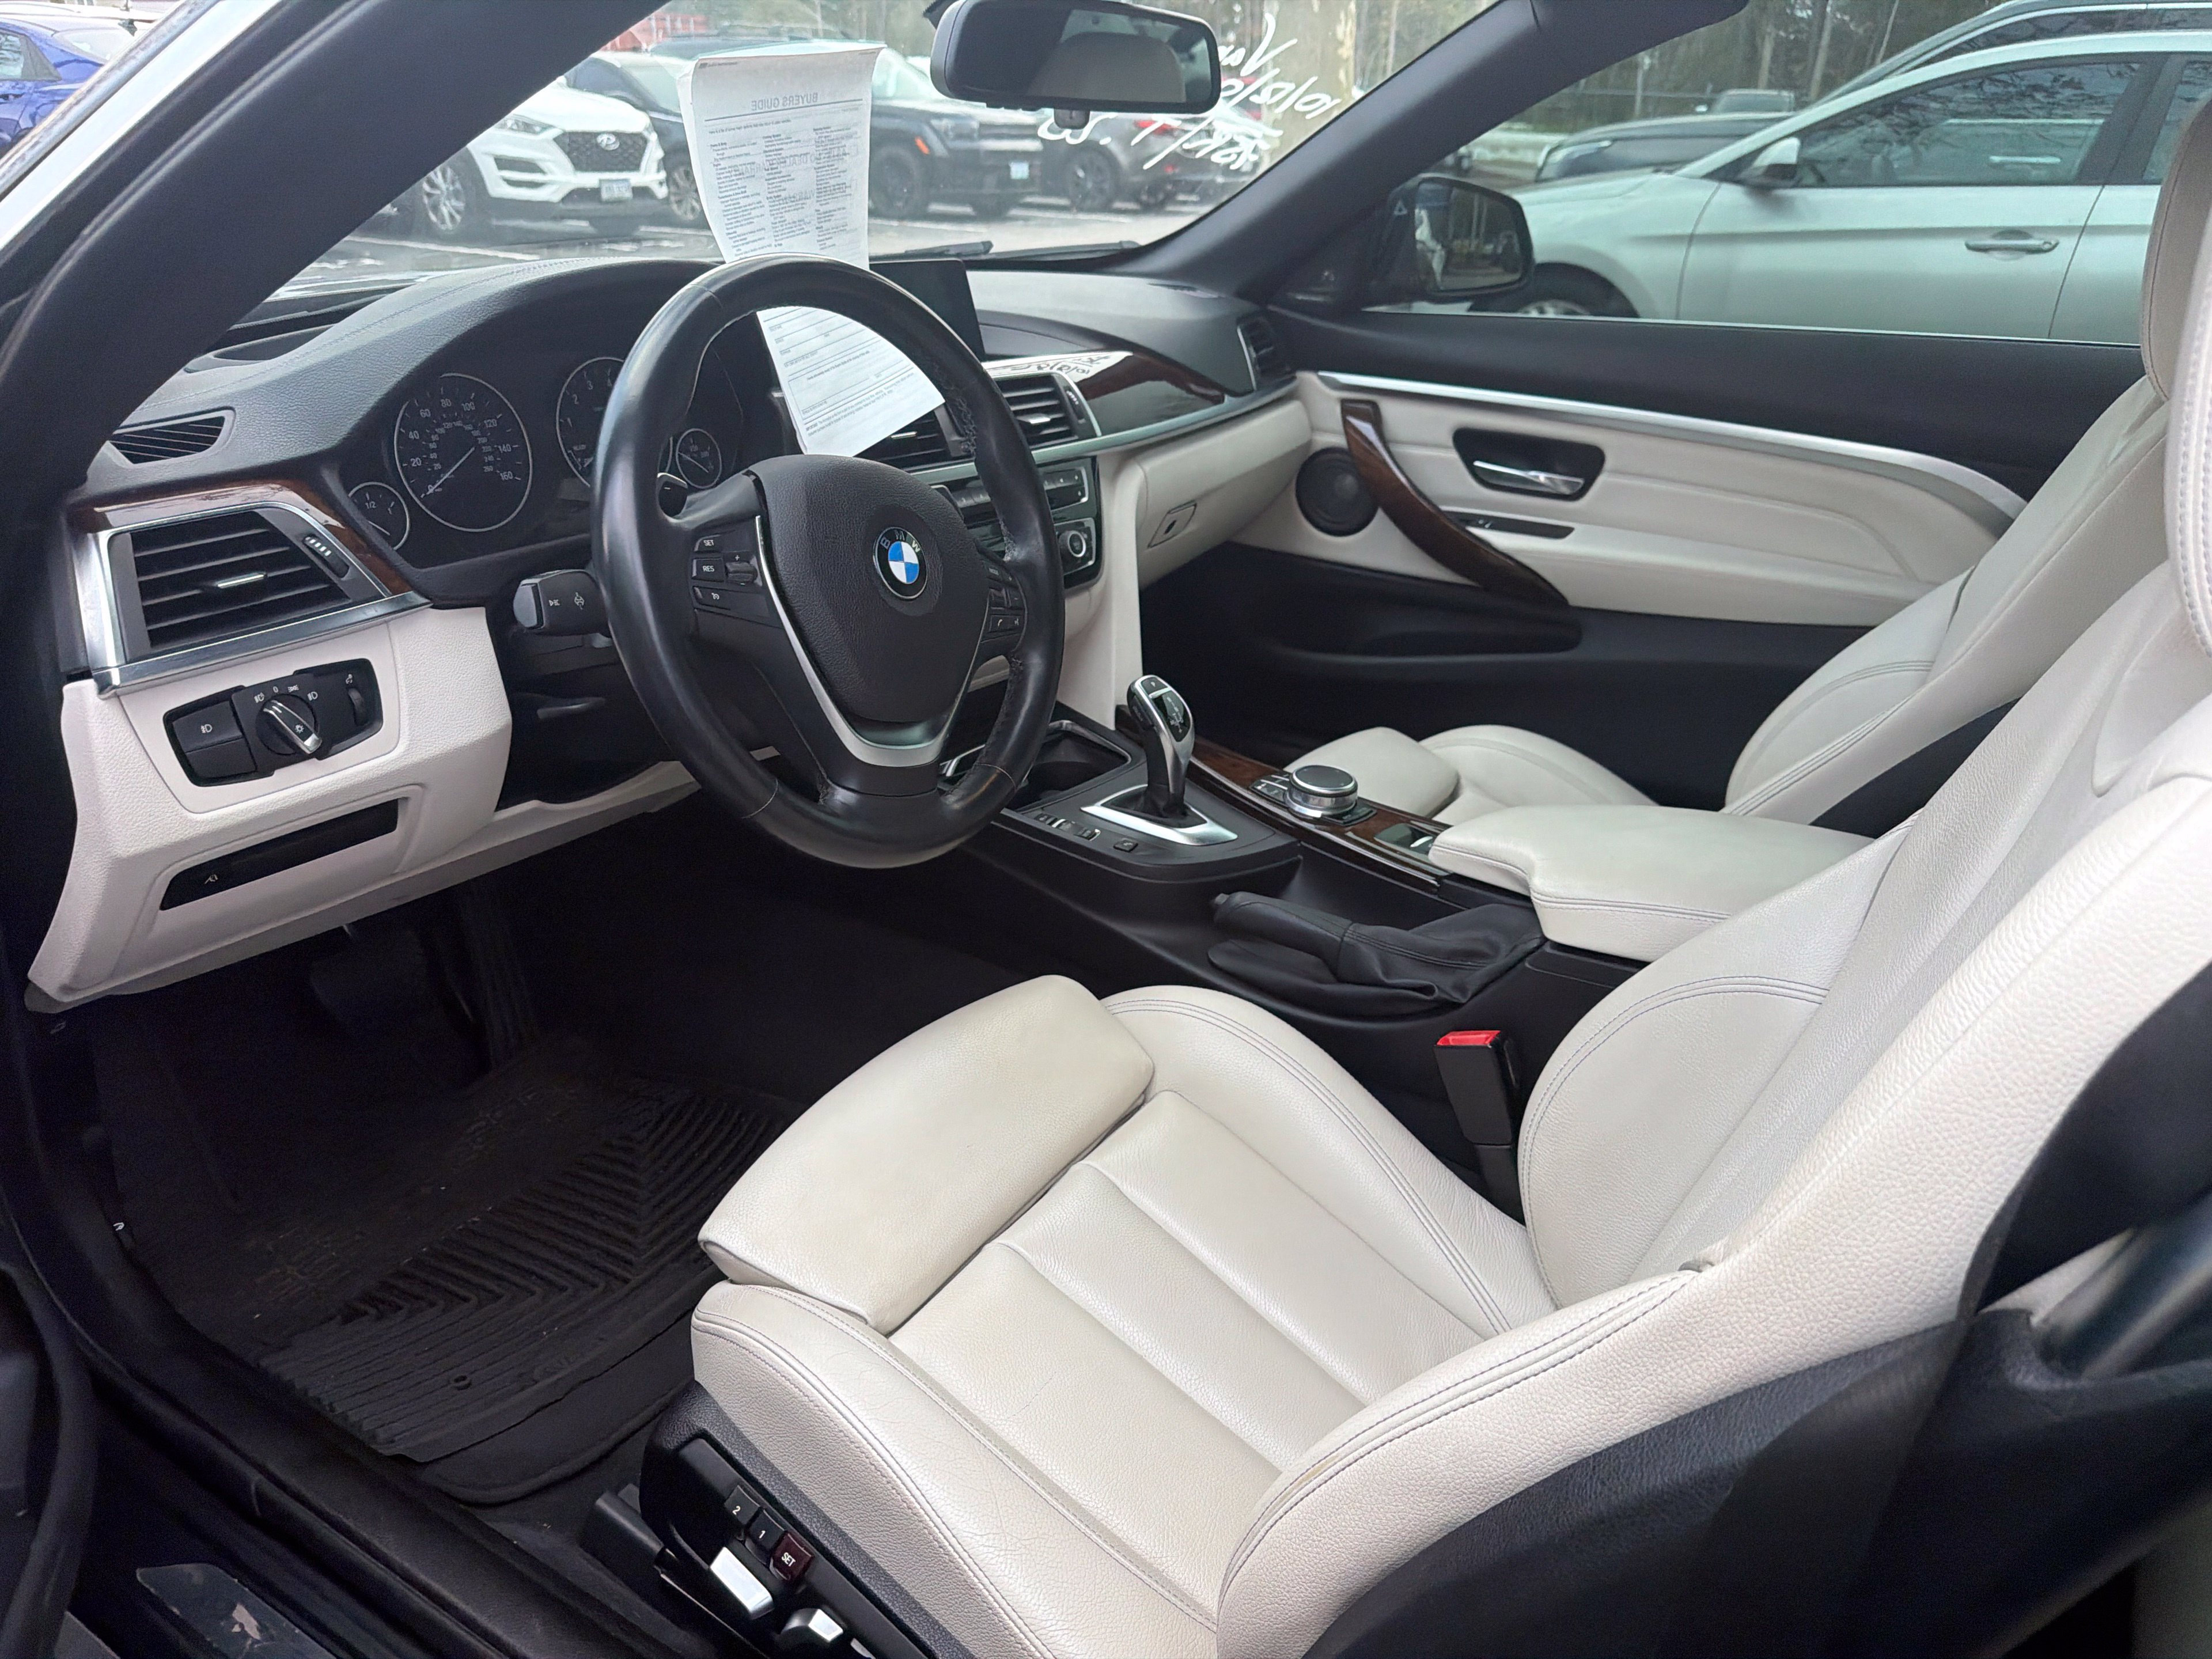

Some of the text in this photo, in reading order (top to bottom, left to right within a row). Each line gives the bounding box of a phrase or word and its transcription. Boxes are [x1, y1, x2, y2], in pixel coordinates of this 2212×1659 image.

[586, 380, 593, 390] 3
[440, 399, 452, 408] 80
[573, 394, 579, 404] 2
[461, 402, 476, 411] 100
[420, 408, 431, 418] 60
[484, 419, 498, 428] 120
[408, 430, 419, 440] 40
[498, 444, 512, 453] 140
[410, 457, 422, 467] 20
[499, 471, 513, 481] 160
[880, 529, 921, 552] BMW
[732, 1505, 741, 1516] 2
[759, 1530, 766, 1539] 1
[781, 1552, 796, 1567] SET
